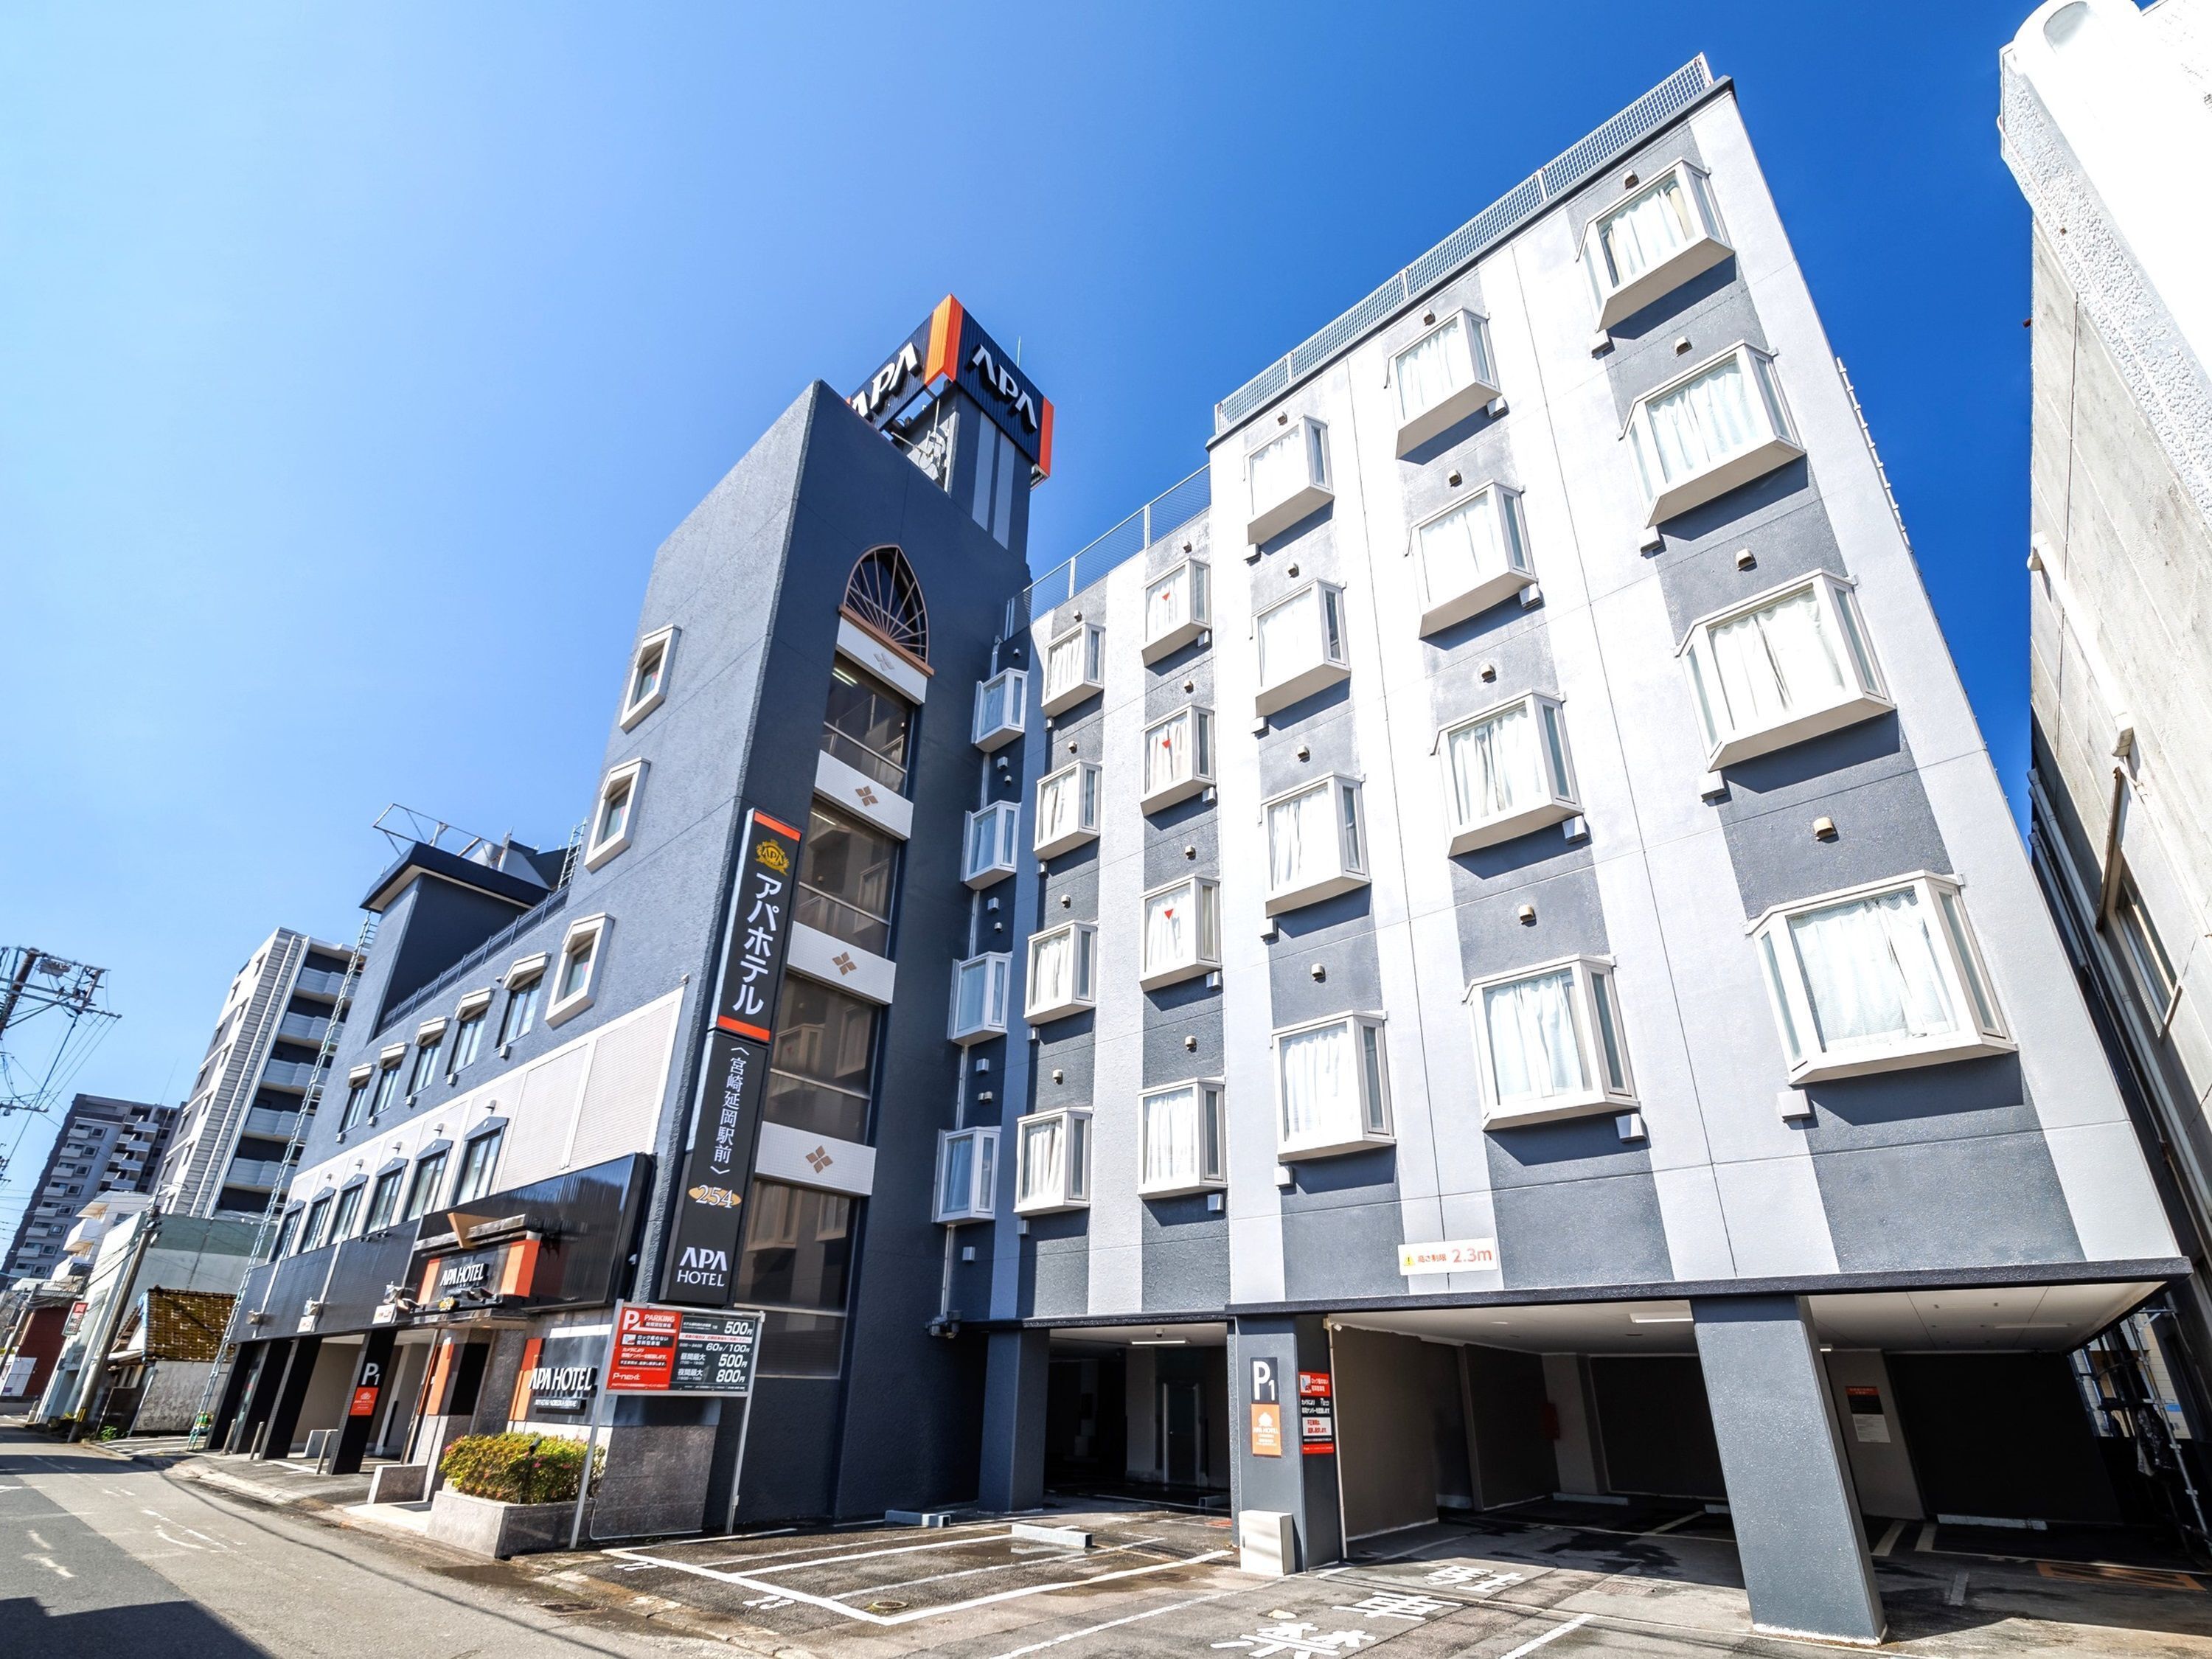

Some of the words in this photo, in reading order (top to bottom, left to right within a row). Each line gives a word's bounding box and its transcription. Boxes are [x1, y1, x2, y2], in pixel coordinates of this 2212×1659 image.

[972, 344, 1038, 430] APA
[732, 872, 782, 1015] アパホテル
[695, 1184, 734, 1208] 254
[679, 1246, 728, 1271] APA
[1452, 1248, 1492, 1263] 2.3m
[439, 1268, 458, 1287] APA
[456, 1263, 484, 1284] HOTEL
[677, 1270, 725, 1287] HOTEL
[644, 1314, 675, 1322] PARKING
[529, 1367, 552, 1390] APA
[550, 1366, 593, 1391] HOTEL
